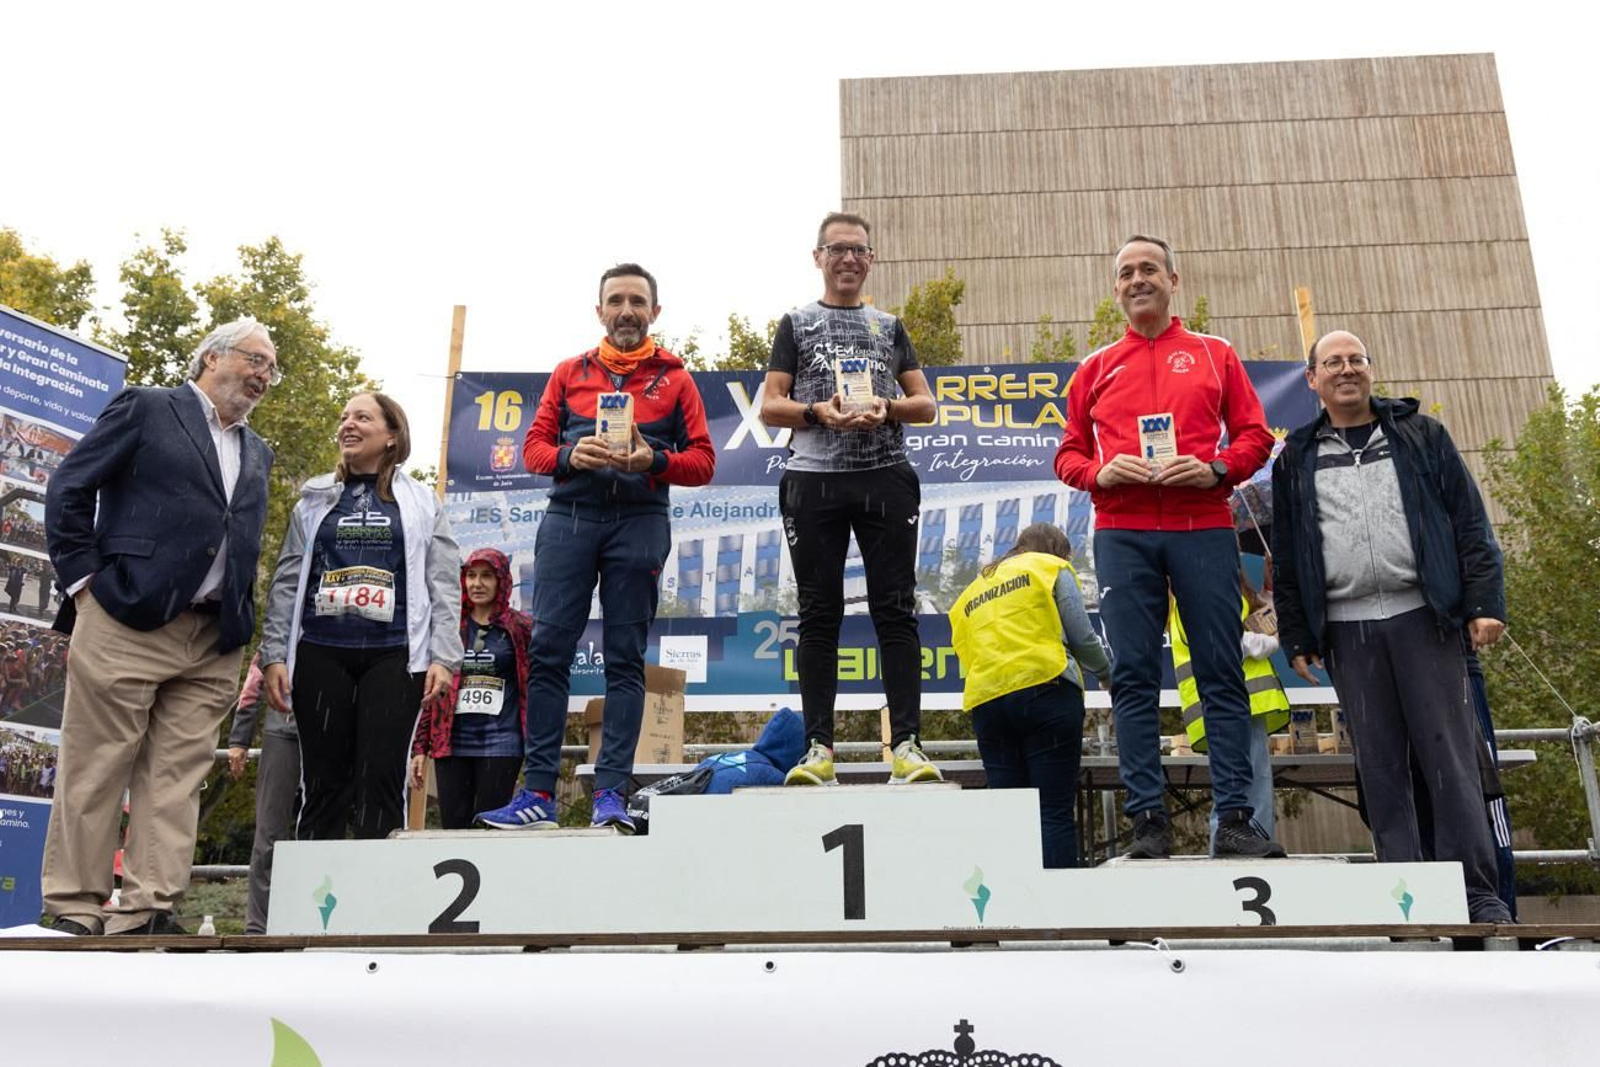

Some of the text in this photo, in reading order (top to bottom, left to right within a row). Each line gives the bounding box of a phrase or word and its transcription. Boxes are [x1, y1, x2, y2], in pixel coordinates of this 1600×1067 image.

[7, 347, 16, 359] y
[17, 350, 49, 370] Gran
[50, 362, 109, 392] Caminata
[51, 346, 65, 359] de
[67, 352, 79, 366] la
[12, 363, 84, 398] Integración
[3, 385, 42, 406] deporte,
[43, 399, 63, 412] vida
[64, 406, 71, 416] y
[475, 389, 523, 431] 16
[1141, 415, 1171, 433] XXV
[905, 434, 968, 451] gran
[928, 449, 1045, 481] Integración
[337, 511, 391, 526] 25
[470, 506, 502, 523] IES
[965, 573, 1030, 618] ORGANIZACION
[665, 648, 702, 659] Sierras
[753, 620, 800, 659] 25
[462, 690, 493, 704] 496
[822, 824, 866, 920] 1
[428, 858, 481, 934] 2
[1232, 876, 1277, 926] 3
